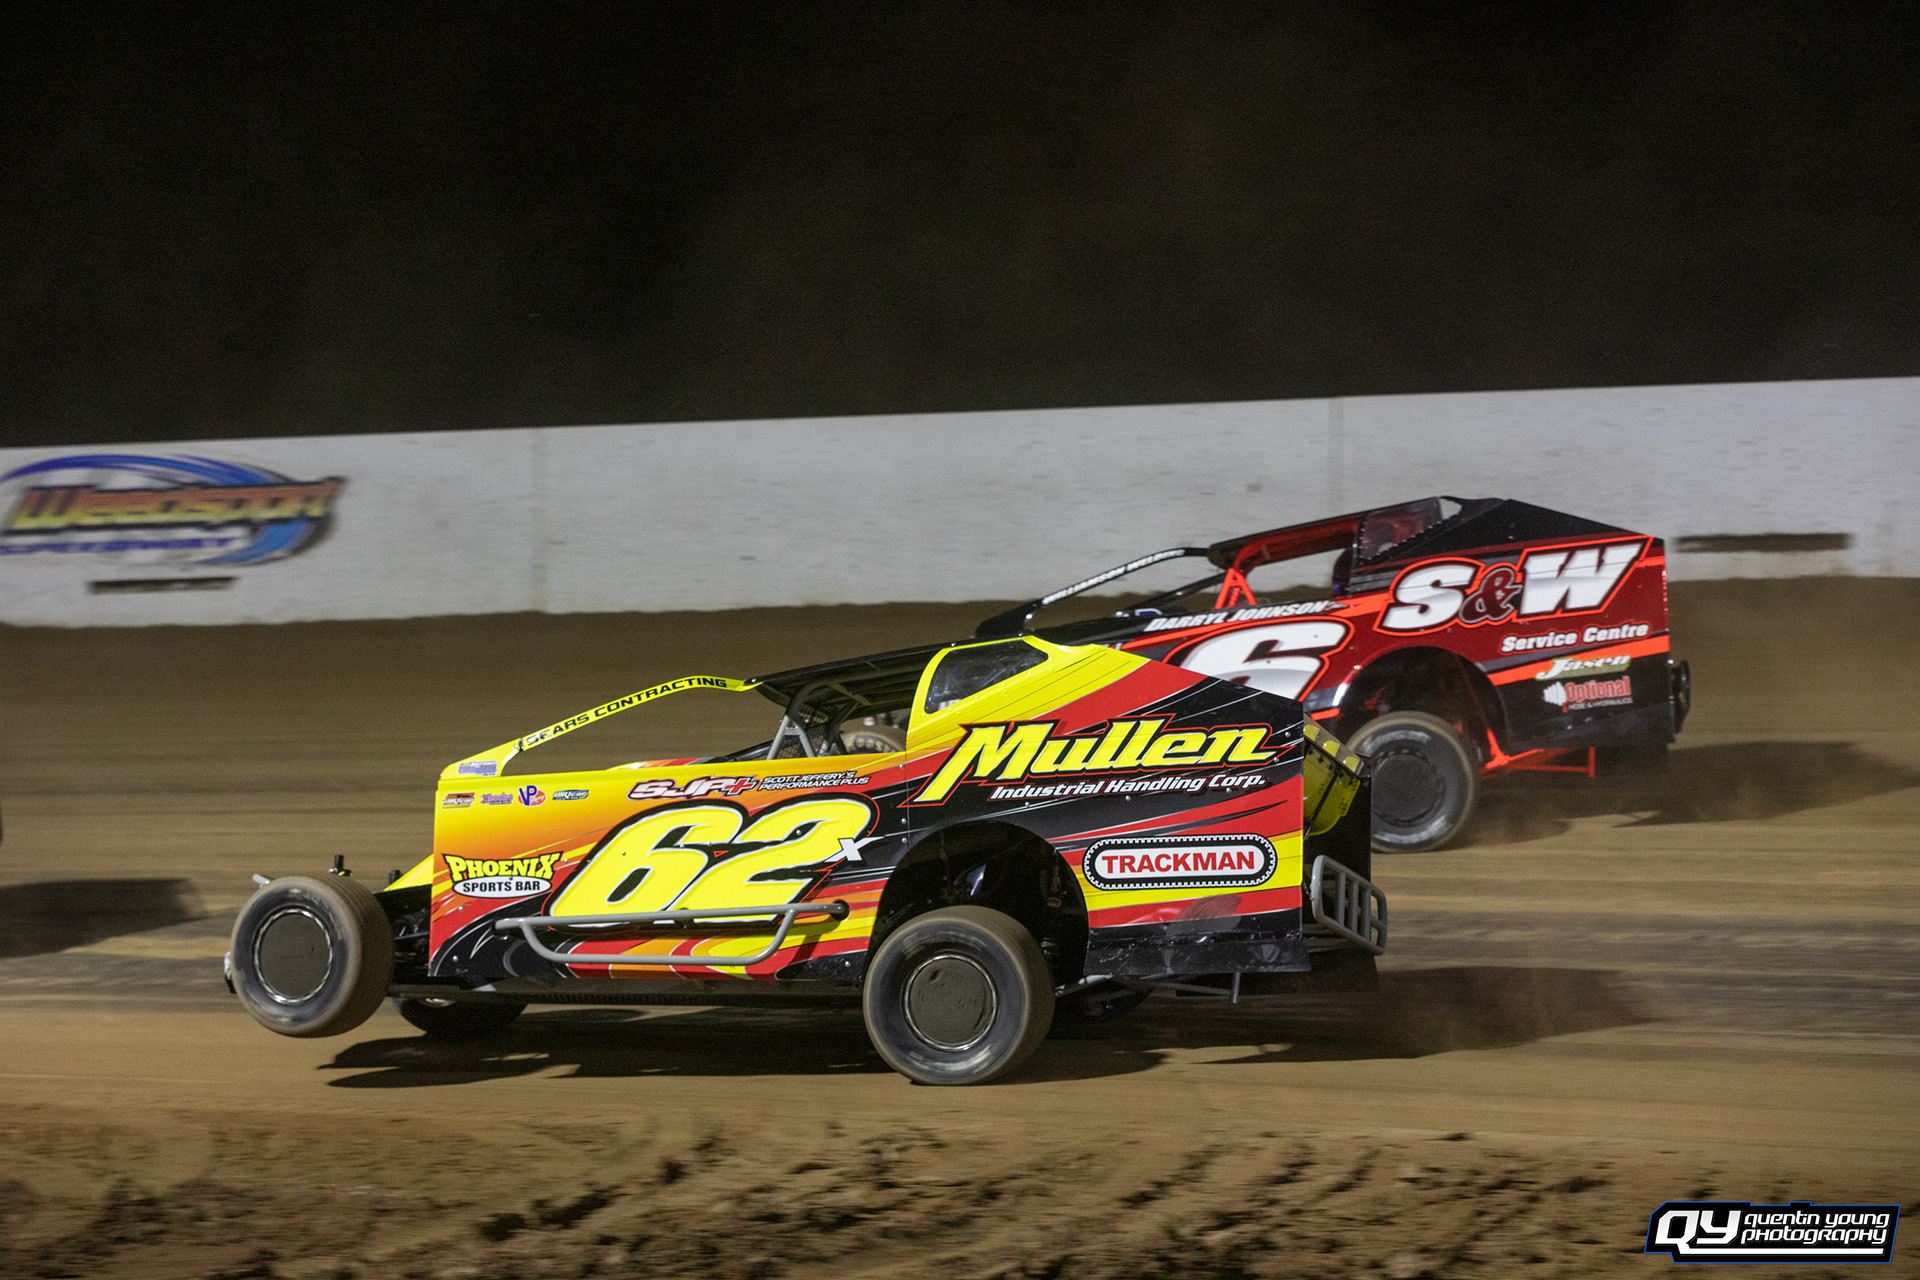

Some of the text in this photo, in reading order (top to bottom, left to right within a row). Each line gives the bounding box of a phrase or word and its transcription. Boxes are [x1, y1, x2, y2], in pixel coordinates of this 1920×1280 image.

[1381, 543, 1643, 630] S&W
[1143, 601, 1331, 632] DARRYL JOHNSON
[1501, 623, 1650, 652] Service Centre
[1565, 675, 1632, 703] Optional
[526, 676, 728, 746] SEARS CONTRACTING
[911, 716, 1282, 803] Mullen
[758, 776, 870, 791] PERFORMANCE PLUS
[763, 770, 857, 784] SCOTT JEFFERY'S
[990, 774, 1266, 800] Industrial Handling Corp.
[443, 851, 562, 883] PHOENIX
[1101, 851, 1255, 874] TRACKMAN
[462, 880, 541, 893] SPORTS BAR
